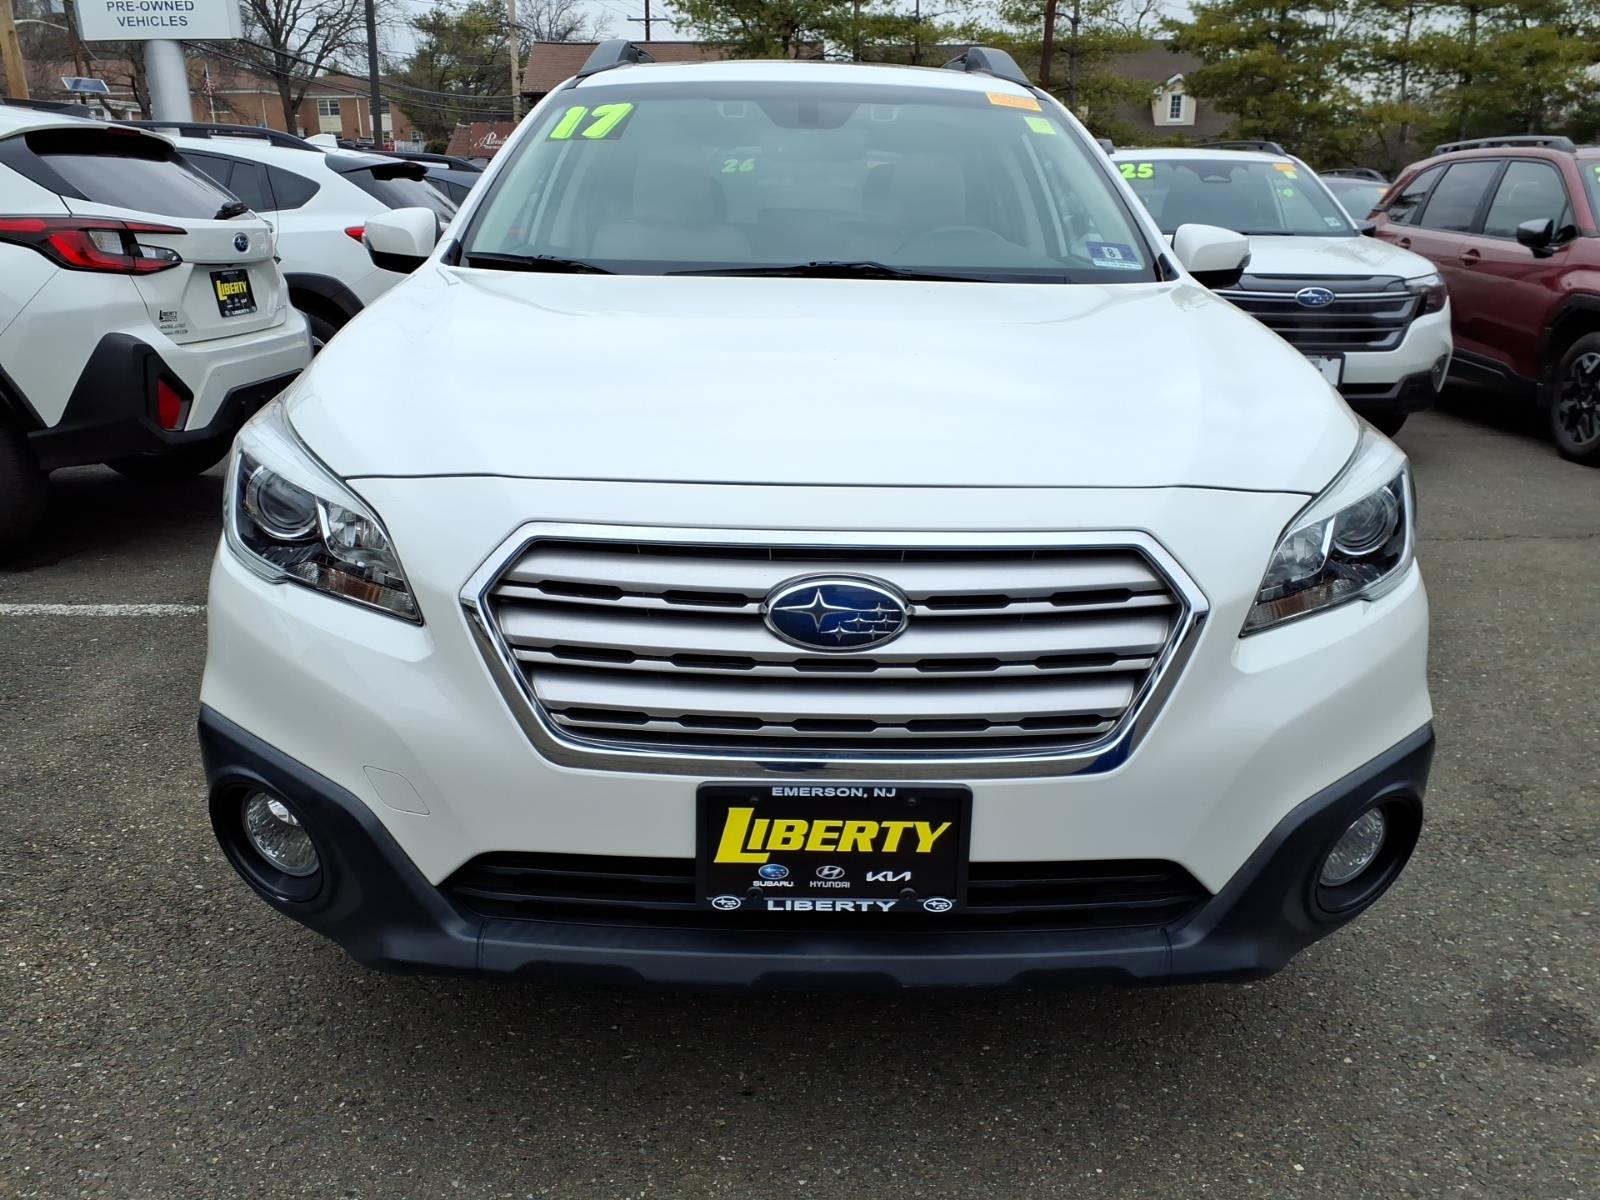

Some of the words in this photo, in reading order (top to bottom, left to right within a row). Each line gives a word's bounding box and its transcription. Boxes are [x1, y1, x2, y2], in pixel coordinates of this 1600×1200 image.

[107, 1, 194, 12] PRE-OWNED
[117, 16, 188, 27] VEHICLES
[549, 103, 634, 139] 17
[721, 159, 755, 172] 26
[1119, 163, 1154, 179] 25
[1107, 248, 1116, 258] 8
[216, 280, 247, 301] LIBERTY
[771, 787, 867, 798] EMERSON,
[874, 787, 896, 797] NJ
[713, 807, 952, 863] LIBERTY
[810, 880, 850, 889] HYUNDAI
[767, 900, 896, 912] LIBERTY
